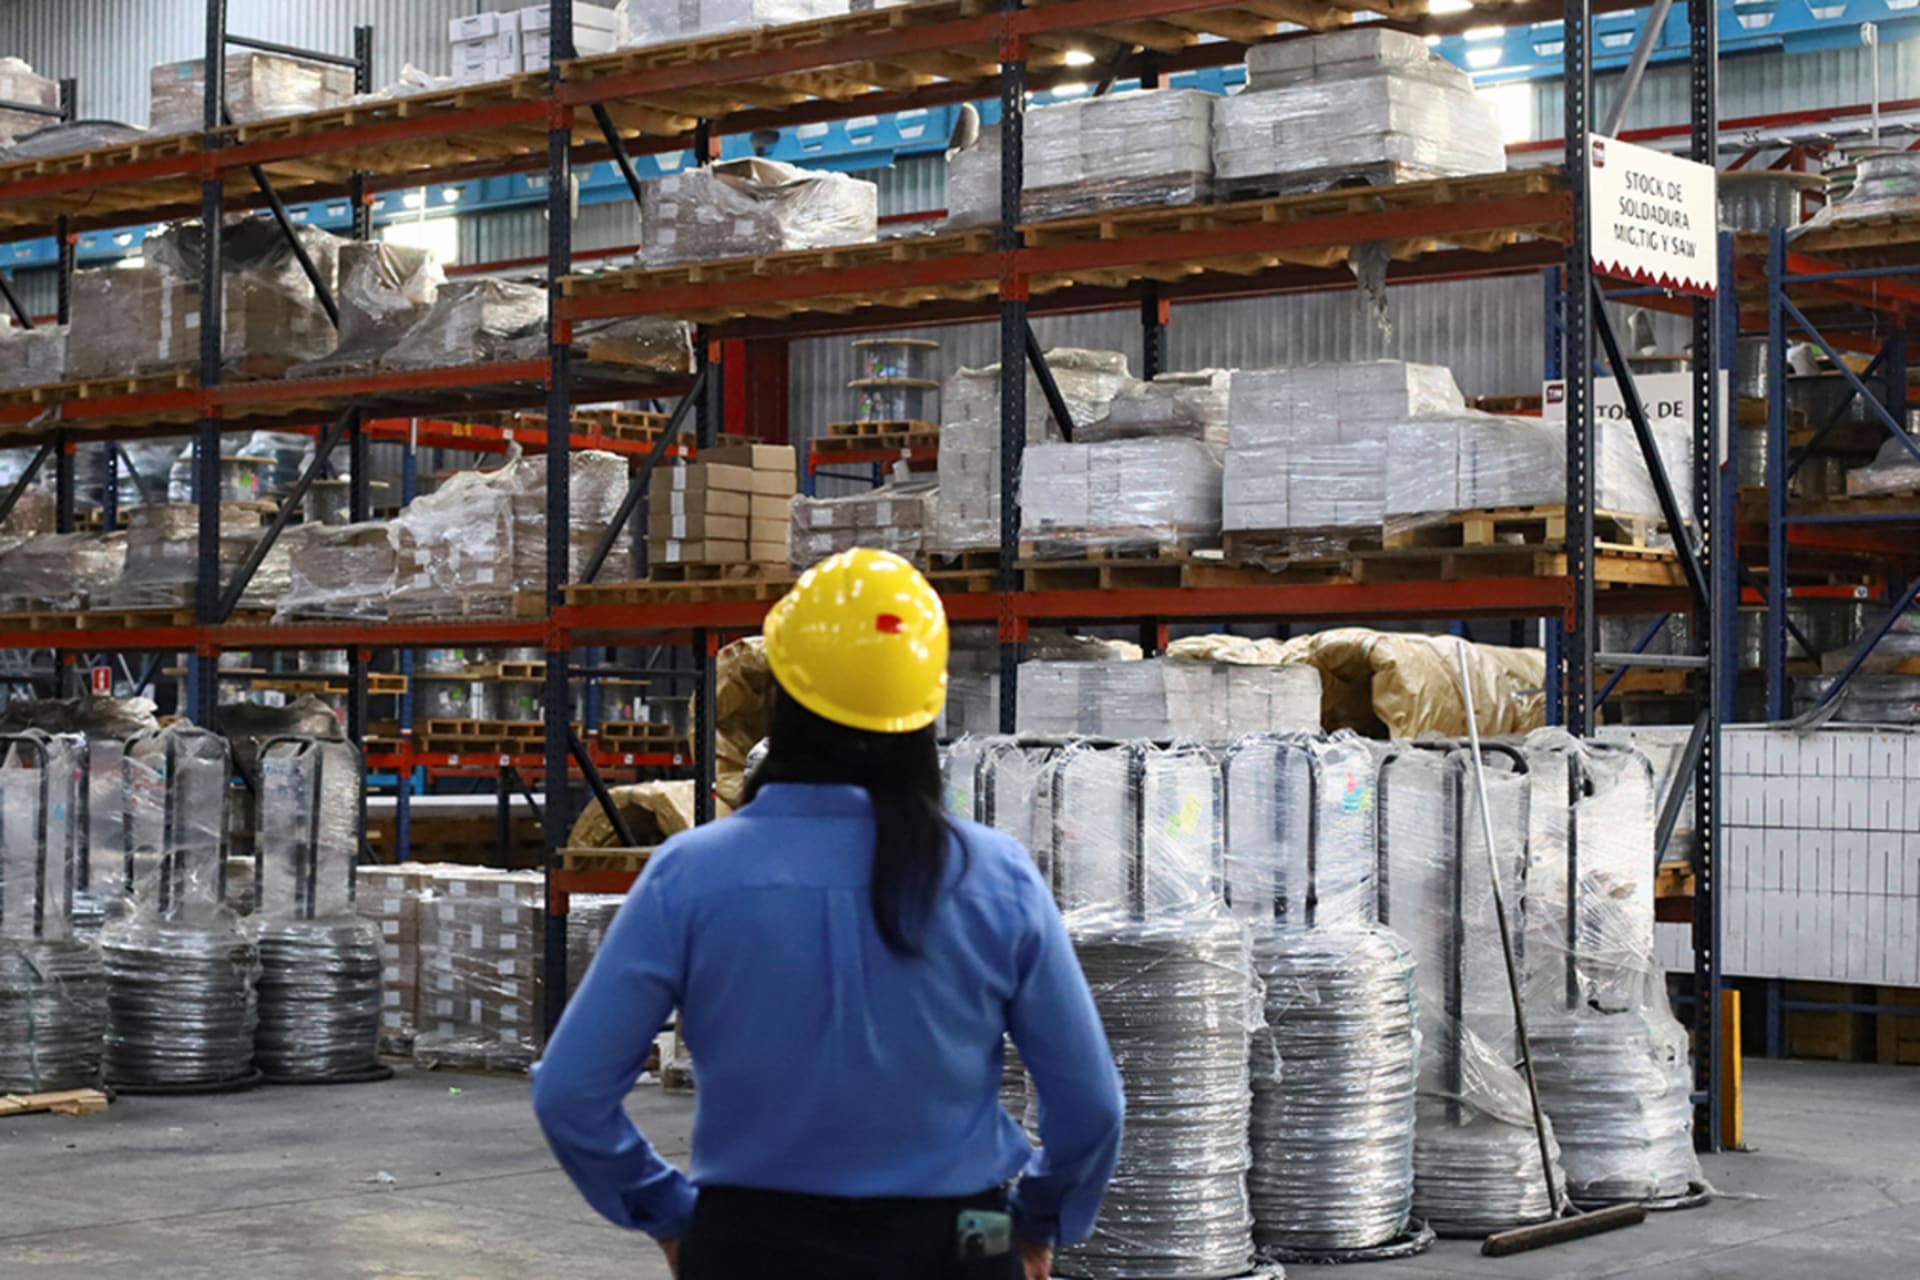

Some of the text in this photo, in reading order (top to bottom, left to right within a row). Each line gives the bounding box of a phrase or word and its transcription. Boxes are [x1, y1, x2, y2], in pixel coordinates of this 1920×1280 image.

[1625, 170, 1682, 203] STOCK DE
[1618, 196, 1690, 229] SOLDADURA
[1661, 235, 1669, 251] Y
[1672, 237, 1696, 257] SAW
[1658, 401, 1683, 418] DE
